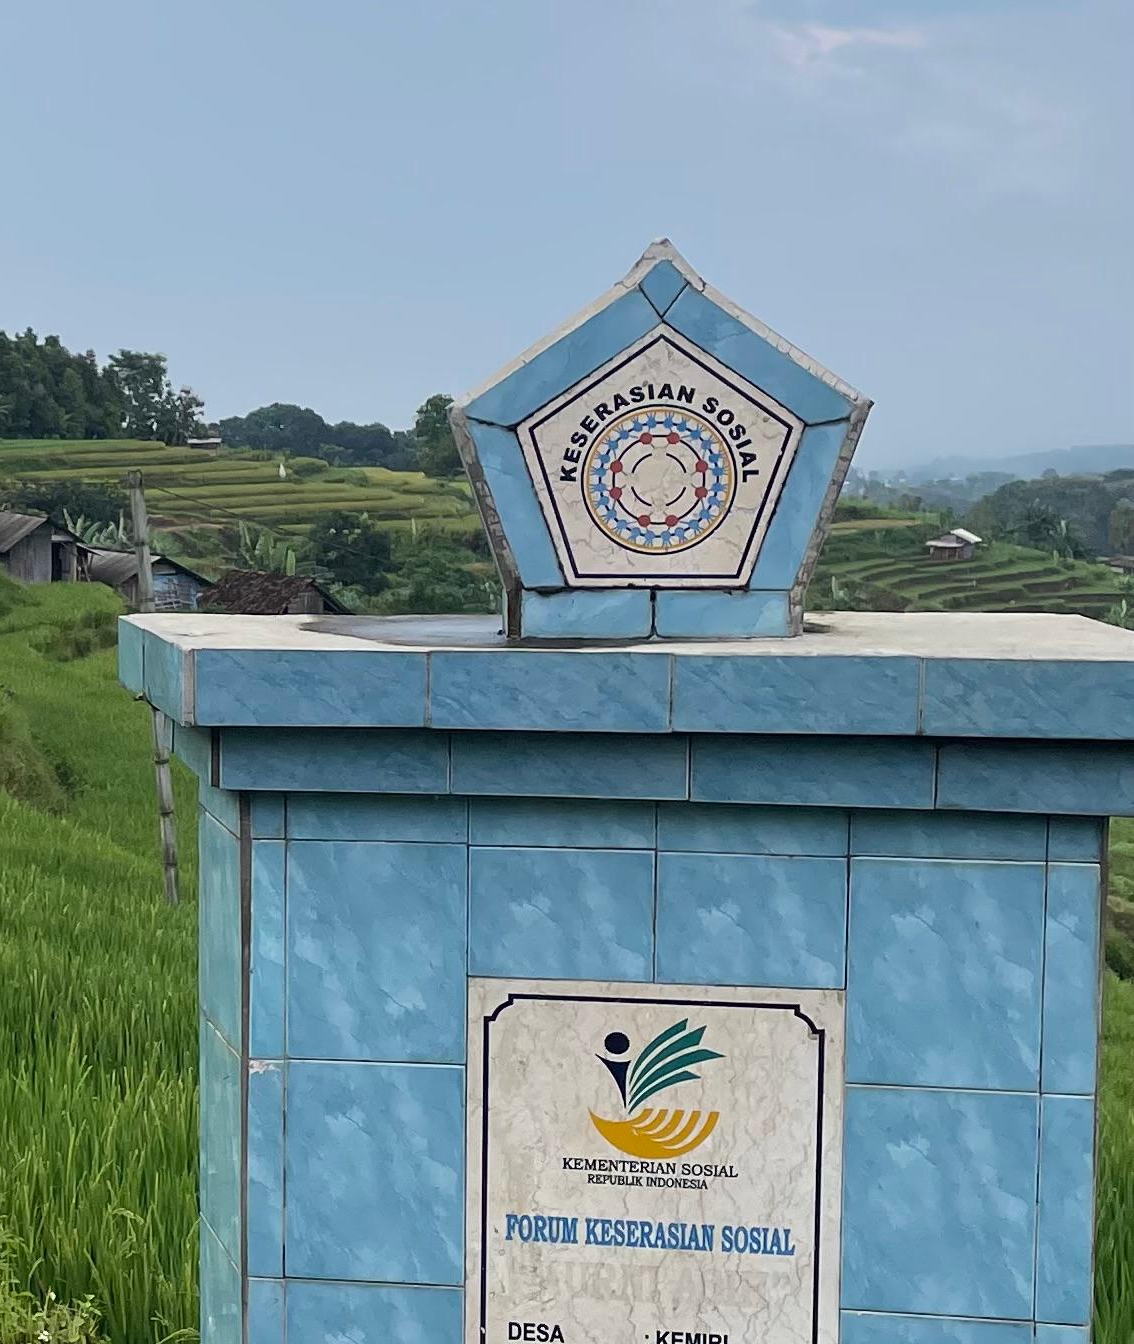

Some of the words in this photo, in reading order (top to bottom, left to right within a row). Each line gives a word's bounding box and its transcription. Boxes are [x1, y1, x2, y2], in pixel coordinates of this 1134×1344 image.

[560, 383, 696, 482] KESERASIAN
[702, 396, 760, 483] SOSIAL
[562, 1157, 677, 1175] KEMENTERIAN
[681, 1163, 738, 1178] SOSIAL
[587, 1174, 643, 1187] REPUBLIK
[646, 1177, 708, 1189] INDONESIA
[505, 1214, 578, 1244] FORUM
[585, 1217, 714, 1252] KESERASIAN
[721, 1225, 795, 1256] SOSIAL
[508, 1322, 564, 1344] DESA
